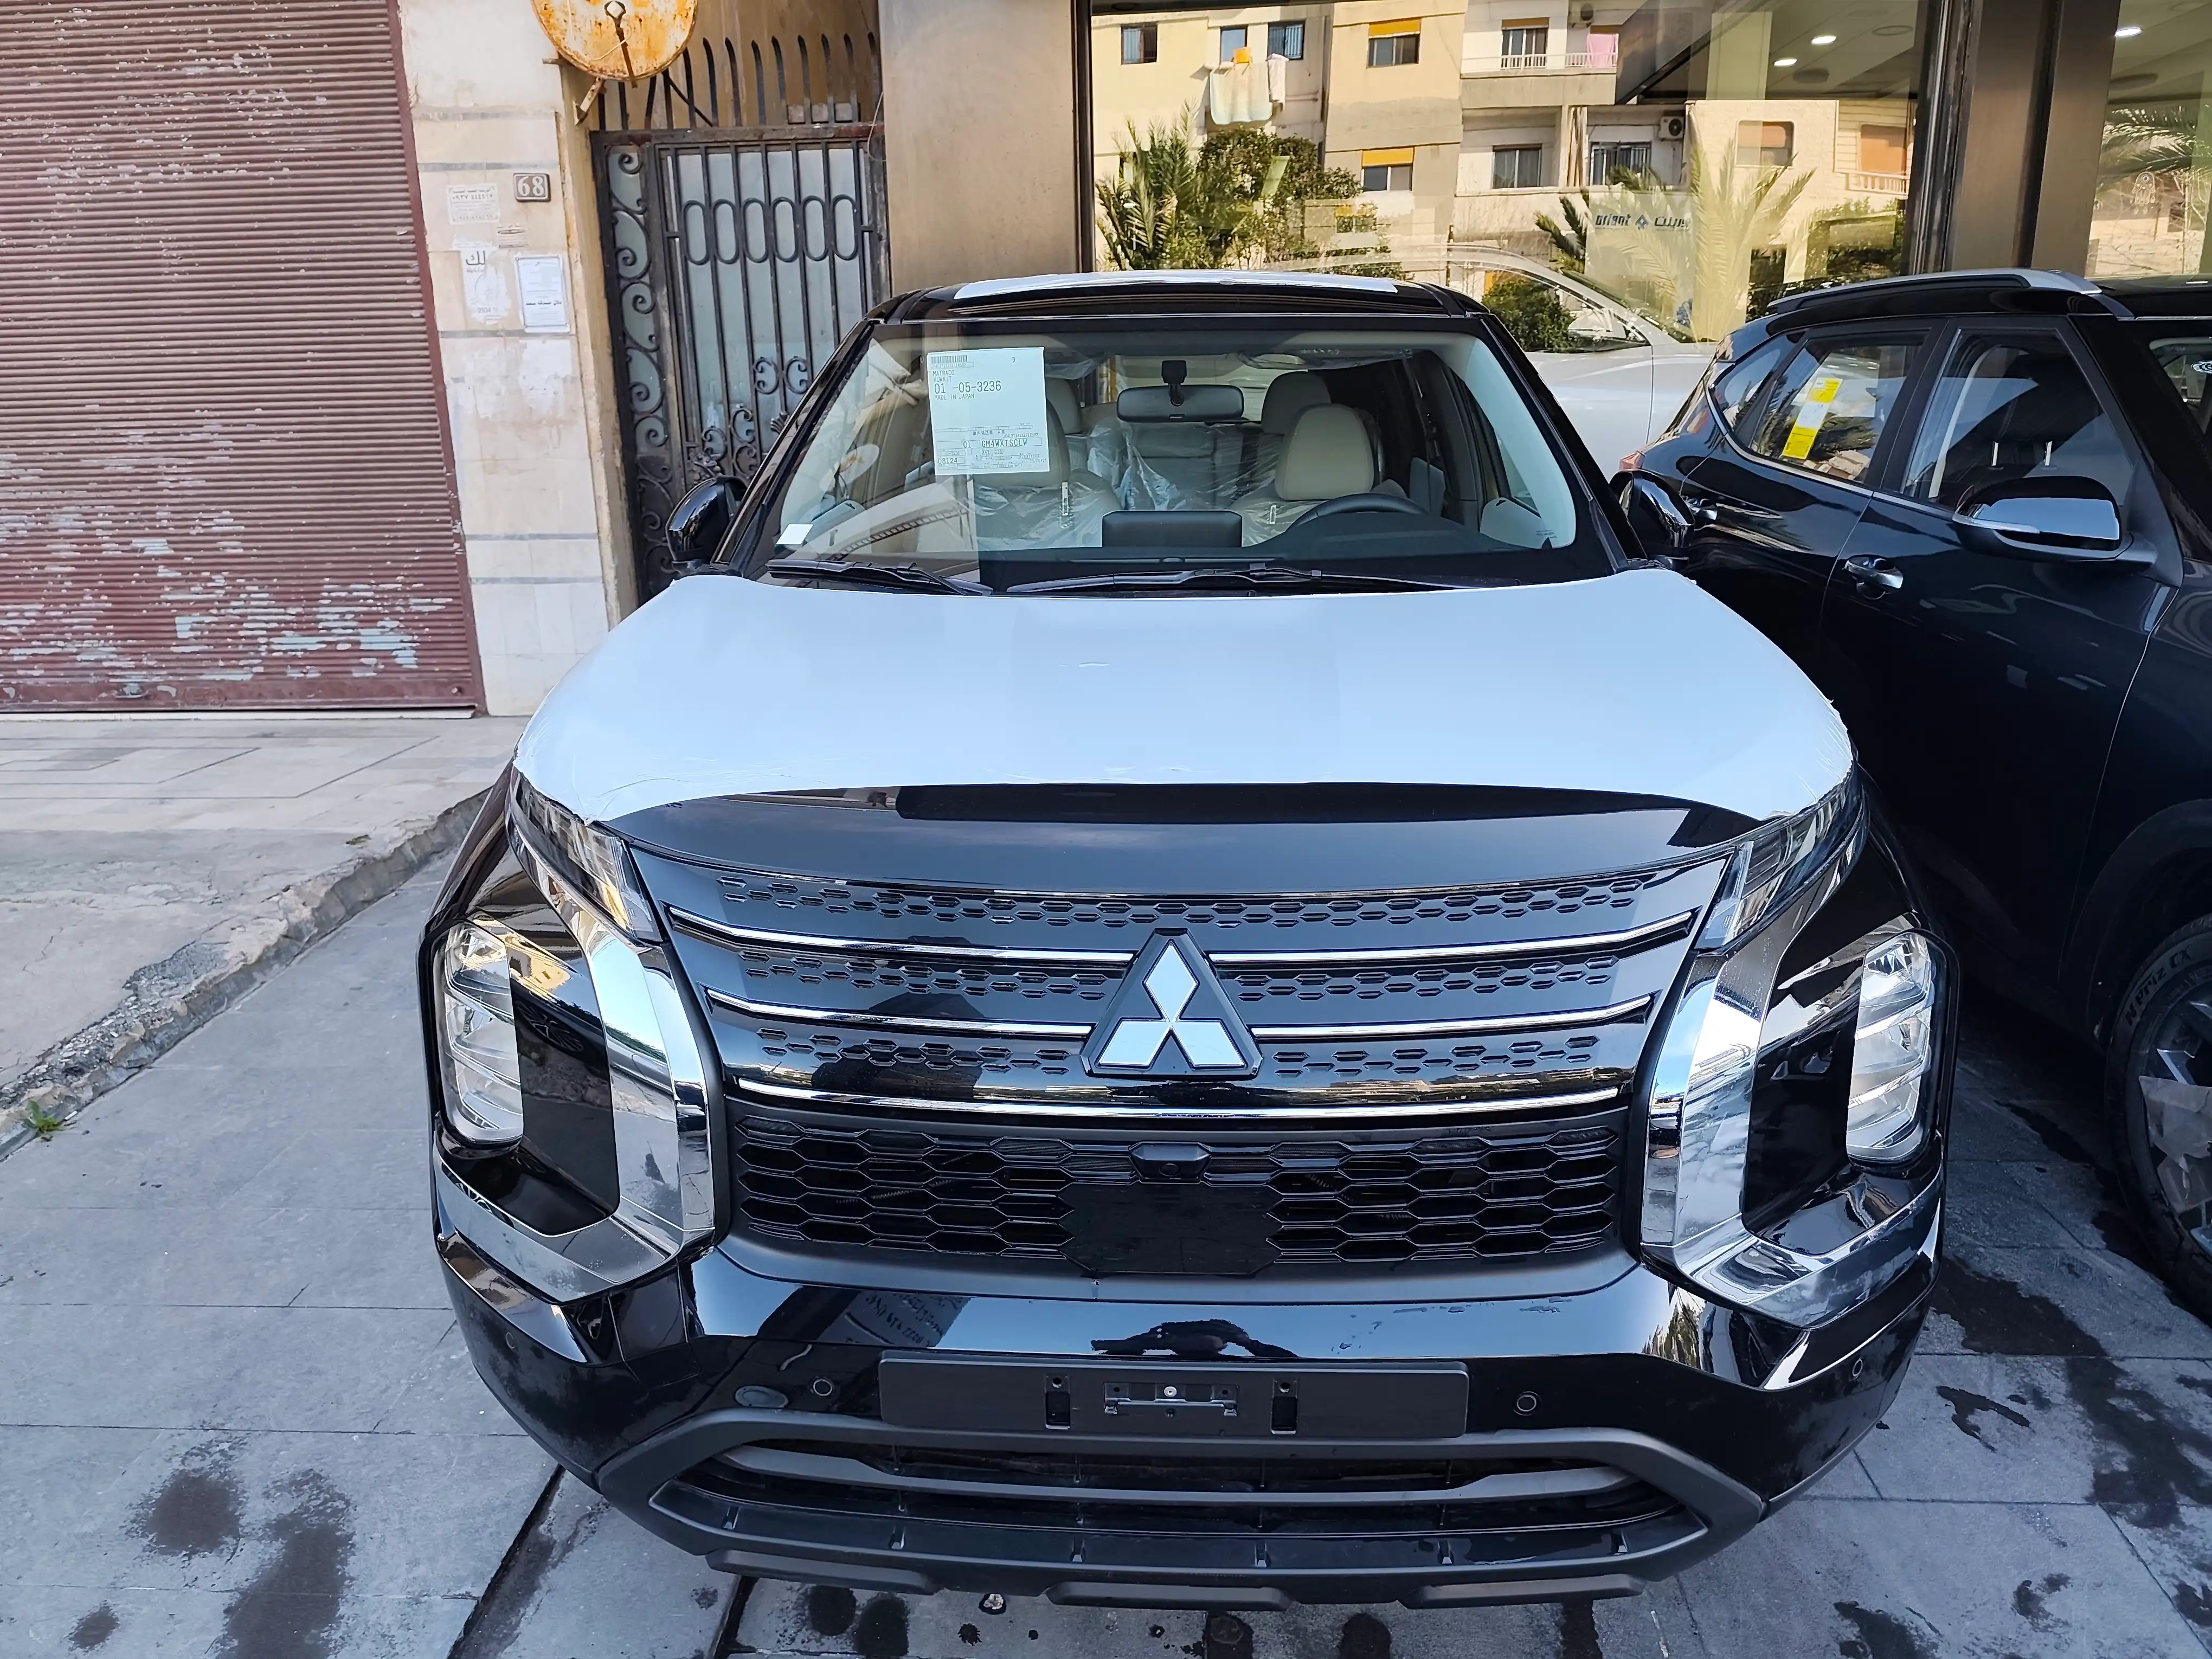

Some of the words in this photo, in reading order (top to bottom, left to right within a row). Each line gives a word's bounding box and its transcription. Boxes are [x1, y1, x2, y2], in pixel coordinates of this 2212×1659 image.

[517, 176, 545, 197] 68
[934, 383, 946, 394] 01
[953, 380, 1002, 393] -05-3236
[982, 439, 1027, 448] GM4WXTSCLW
